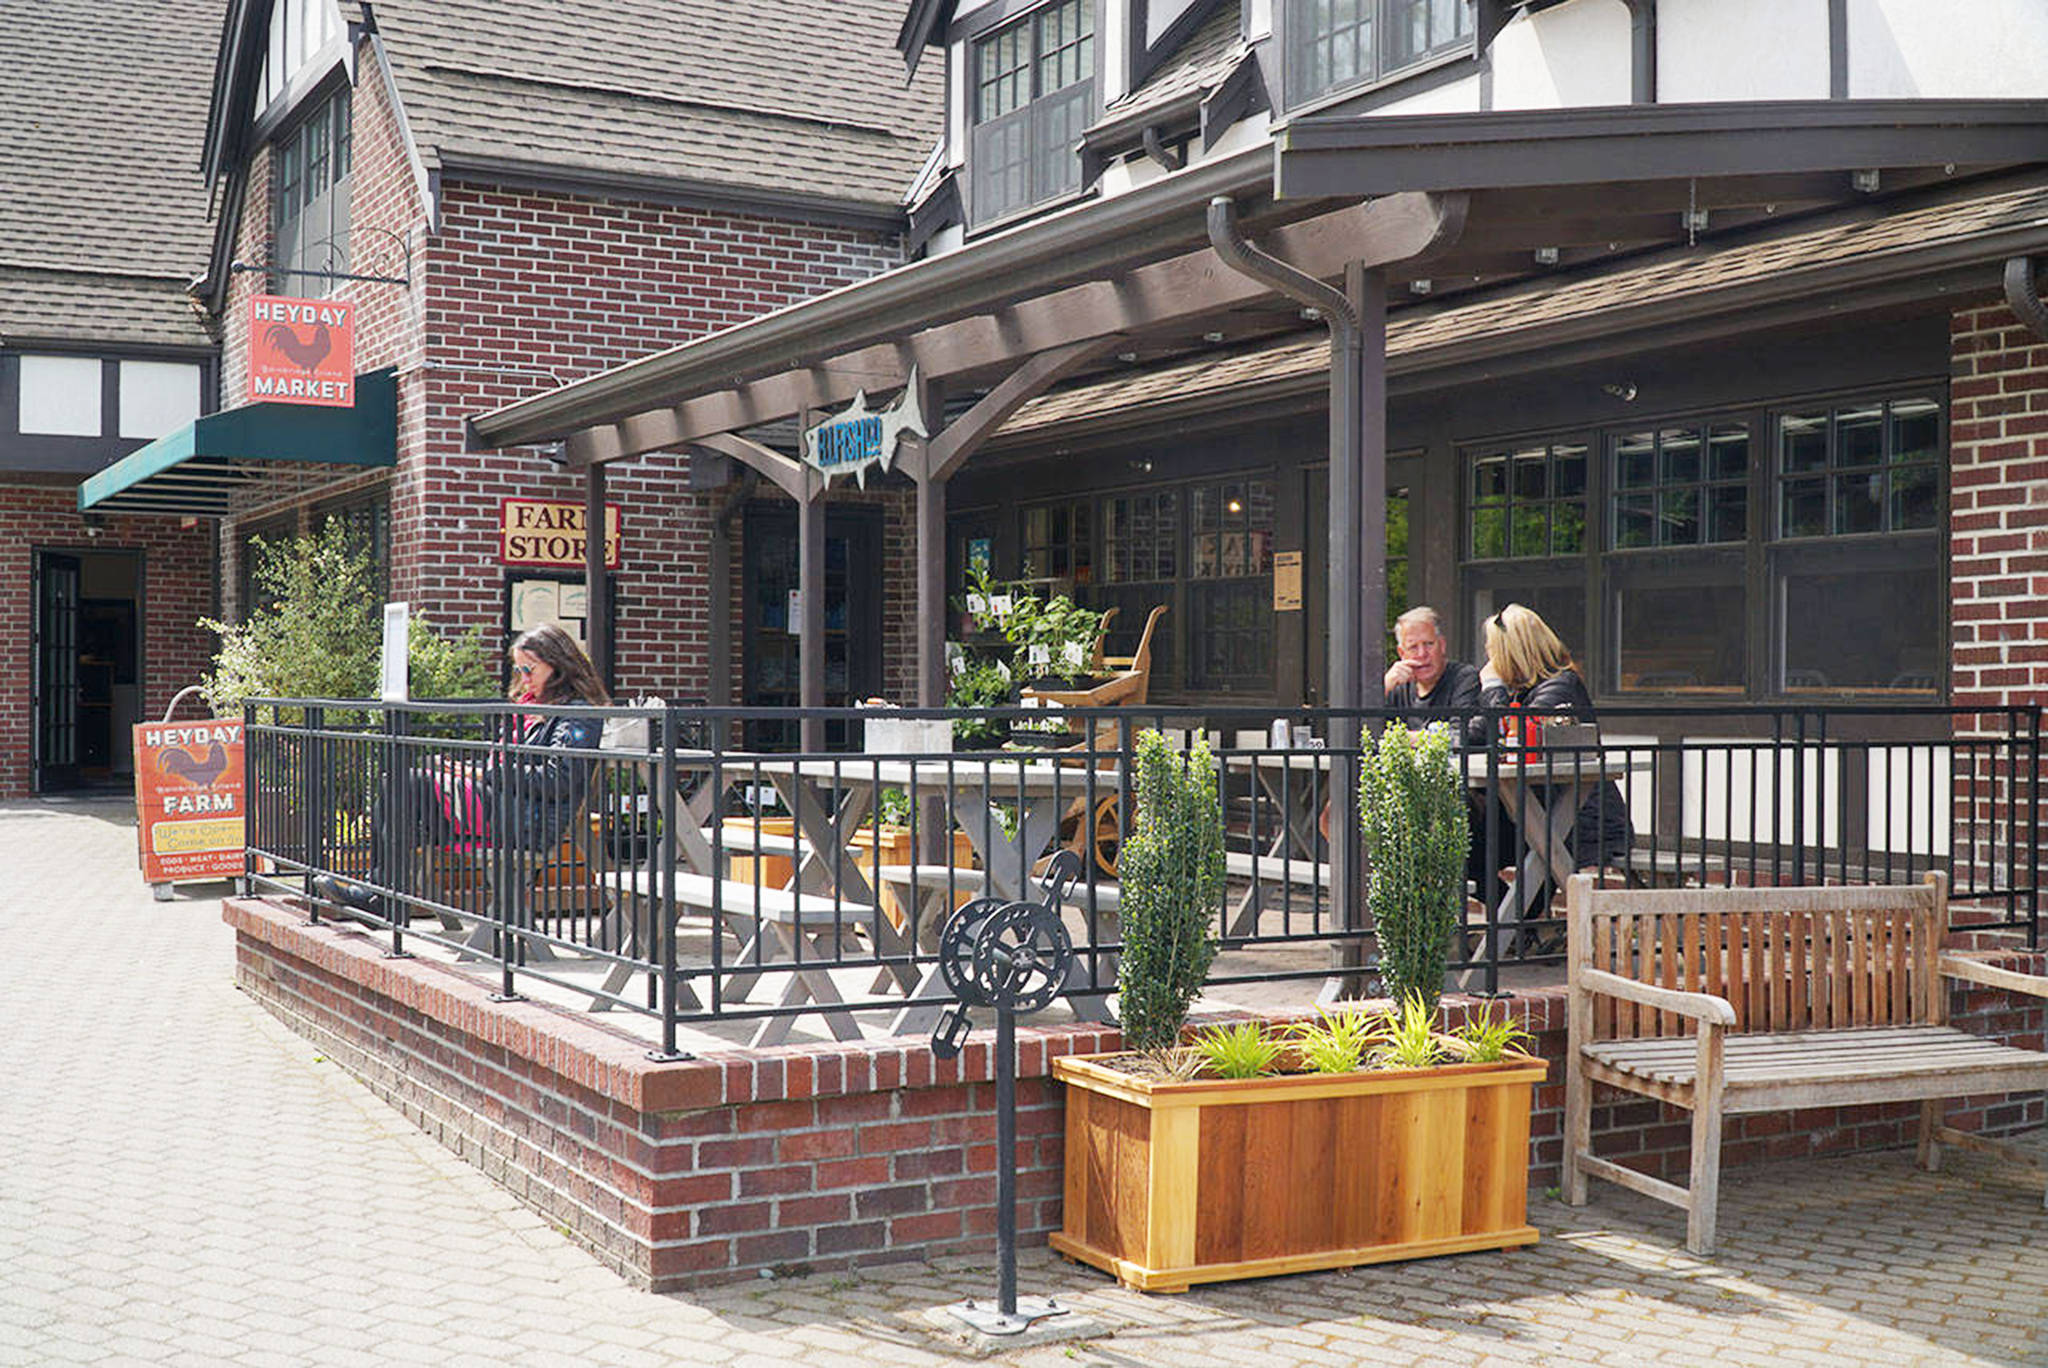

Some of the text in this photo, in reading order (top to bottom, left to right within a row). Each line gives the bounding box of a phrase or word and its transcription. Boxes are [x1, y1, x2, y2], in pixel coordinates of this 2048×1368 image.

[255, 302, 346, 327] HEYDAY
[255, 376, 348, 400] MARKET
[515, 506, 587, 531] FAR
[146, 726, 242, 747] HEYDAY
[164, 793, 234, 815] FARM
[160, 857, 183, 866] EGGS
[190, 854, 213, 863] MEAT
[163, 864, 205, 874] PRODUCE
